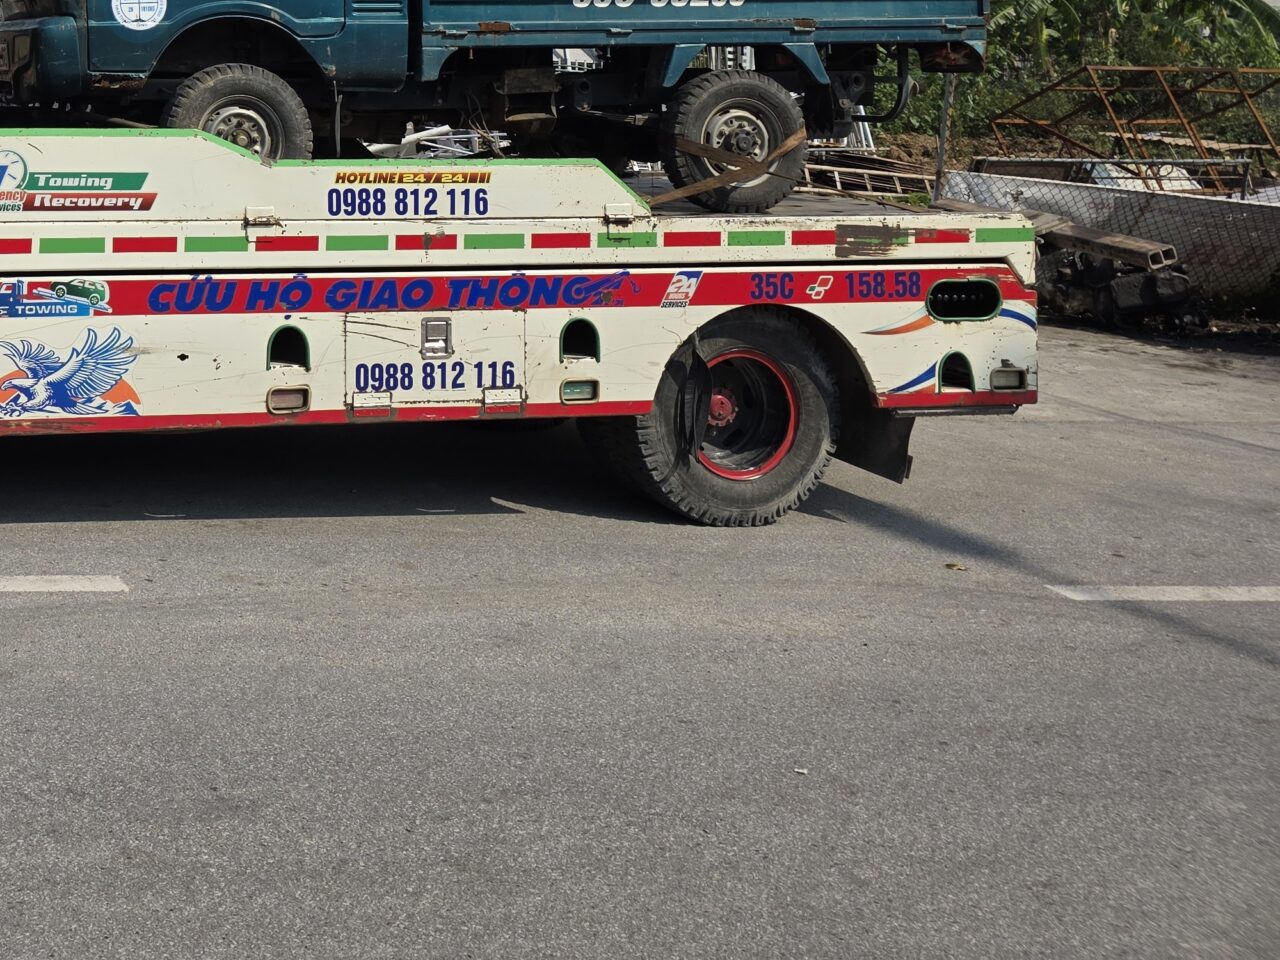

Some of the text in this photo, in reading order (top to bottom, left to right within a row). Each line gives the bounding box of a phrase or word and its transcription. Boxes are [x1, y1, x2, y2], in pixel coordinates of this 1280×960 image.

[33, 173, 114, 190] Towing
[335, 172, 398, 184] HOTLINE
[33, 194, 144, 210] Recovery
[327, 187, 489, 216] 0988 812 116
[749, 271, 921, 301] 35C 158.58
[146, 272, 590, 320] CỨU HỘ GIAO THÔNG
[15, 303, 78, 315] TOWING
[660, 301, 688, 309] SERVICES
[354, 361, 516, 393] 0988 812 116
